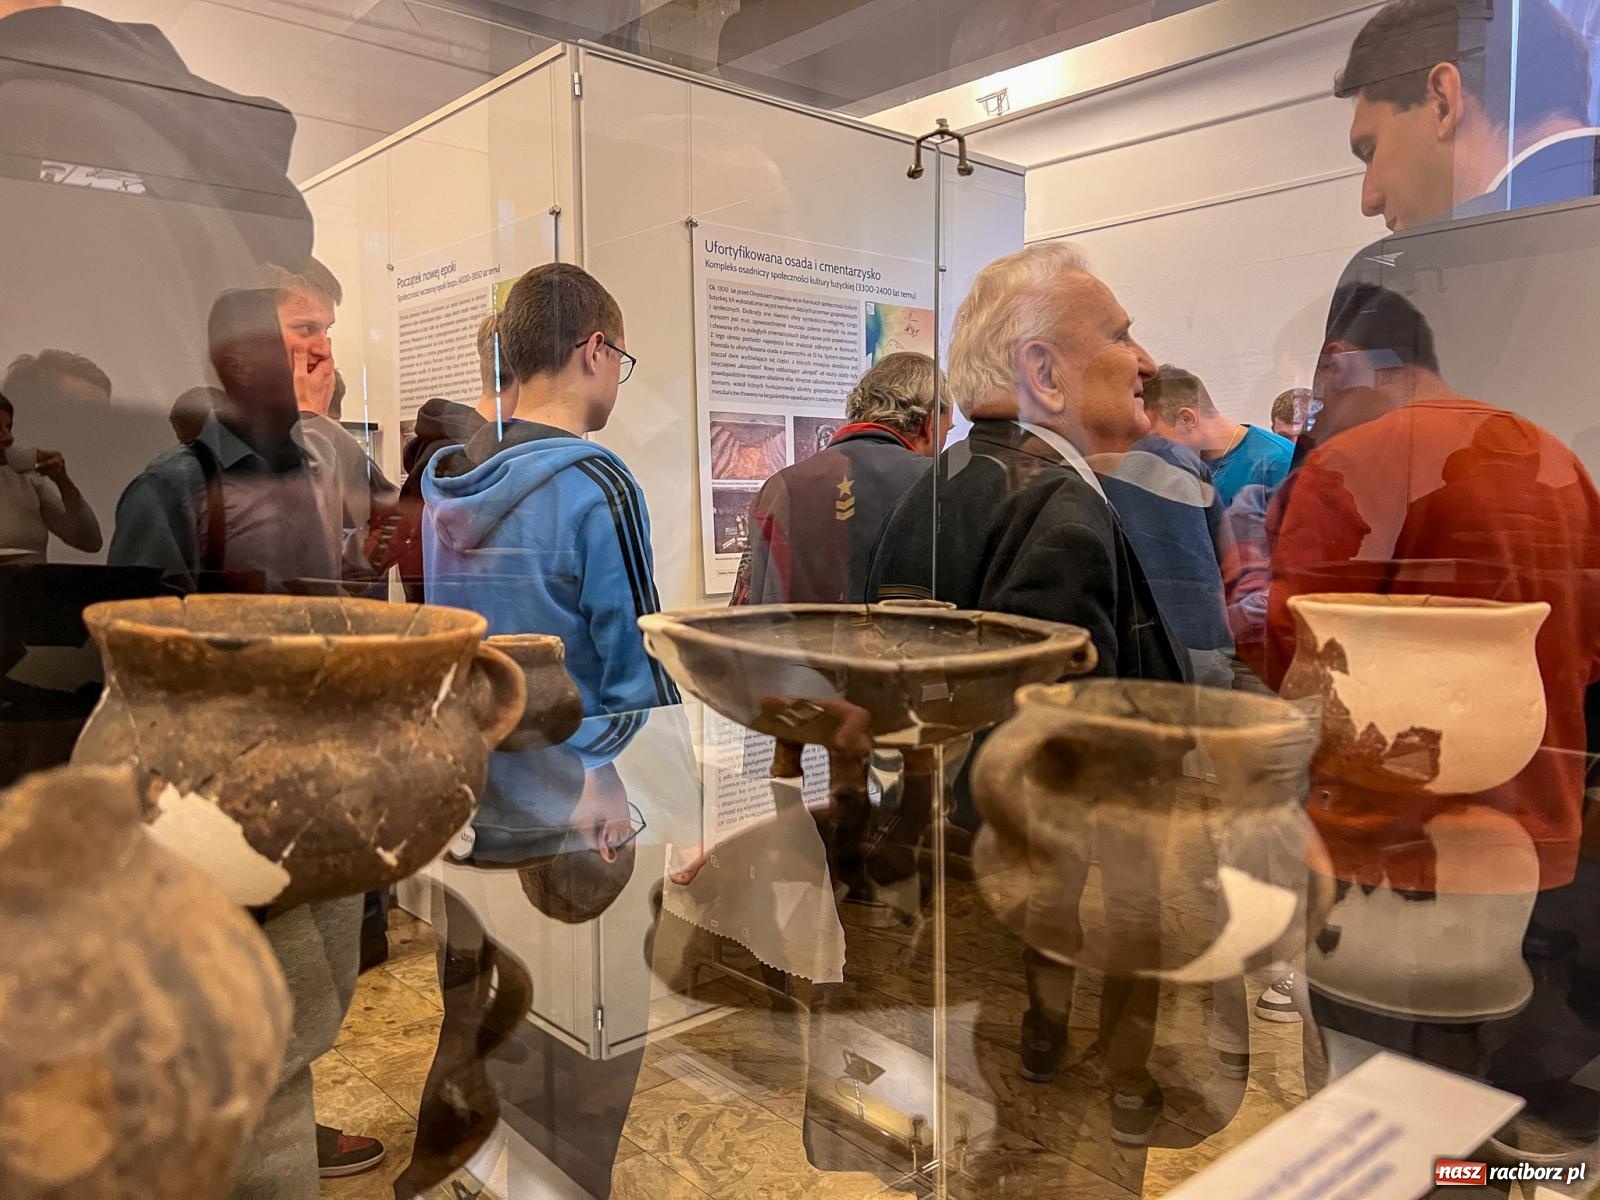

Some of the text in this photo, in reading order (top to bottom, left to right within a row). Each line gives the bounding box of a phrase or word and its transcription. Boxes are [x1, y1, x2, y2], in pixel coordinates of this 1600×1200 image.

[397, 260, 457, 288] Początek nowej epoki
[705, 239, 881, 281] Ufortyfikowana osada i cmentarzysko
[705, 259, 737, 272] Kompleks
[738, 266, 770, 279] osadniczy
[855, 283, 891, 296] (3300-2400
[892, 288, 900, 297] lat
